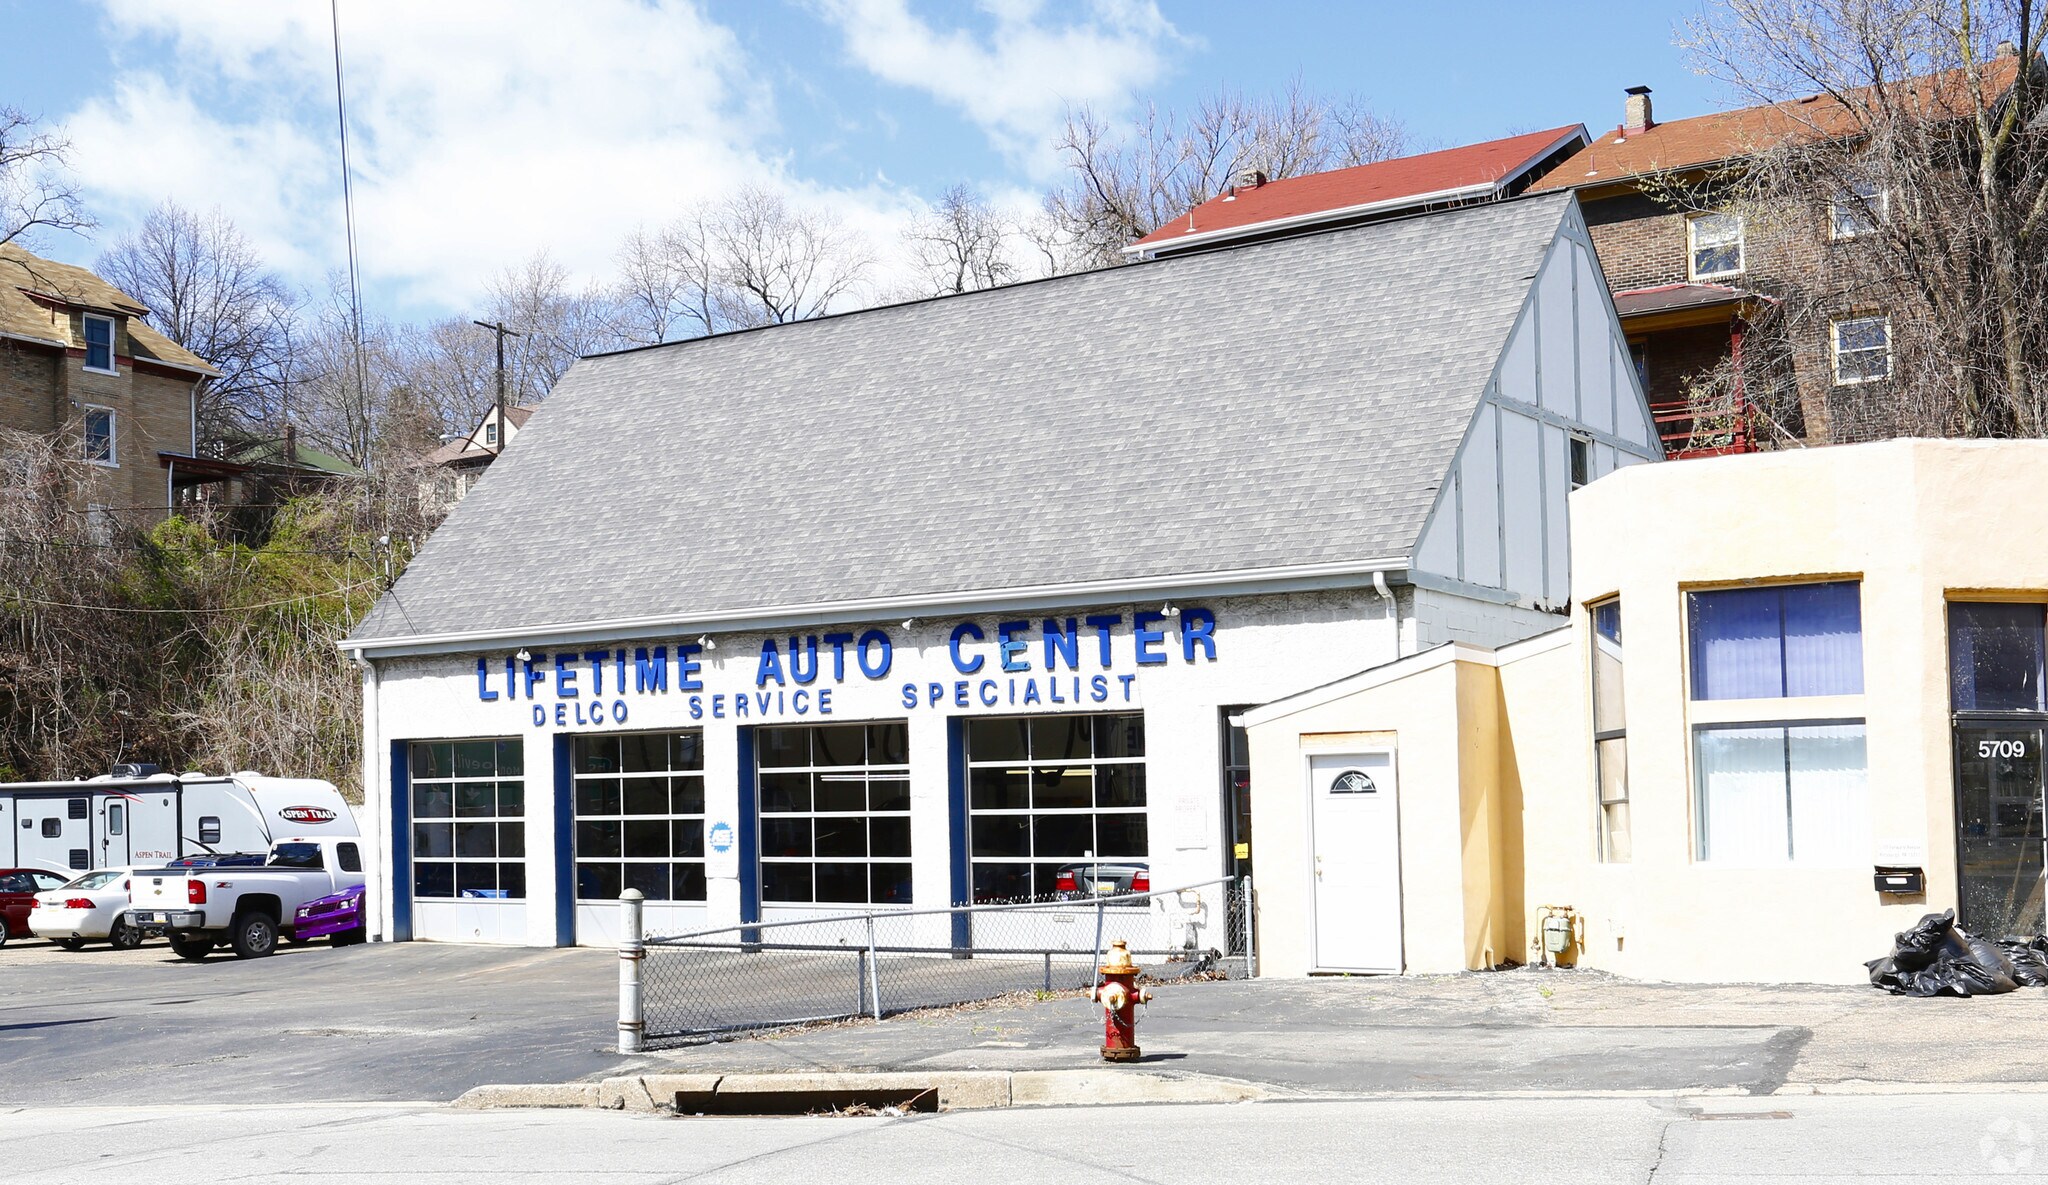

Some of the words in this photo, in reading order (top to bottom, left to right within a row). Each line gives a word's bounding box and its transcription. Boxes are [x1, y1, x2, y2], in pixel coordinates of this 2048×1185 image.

[477, 646, 703, 701] LIFETIME
[756, 630, 893, 687] AUTO
[948, 608, 1217, 674] CENTER
[533, 699, 628, 726] DELCO
[690, 688, 832, 719] SERVICE
[902, 673, 1136, 709] SPECIALIST
[1978, 740, 2025, 758] 5709
[280, 809, 308, 819] ASPEN
[308, 809, 337, 819] TRAIL
[134, 851, 153, 859] ASPEN
[154, 850, 173, 859] TRAIL
